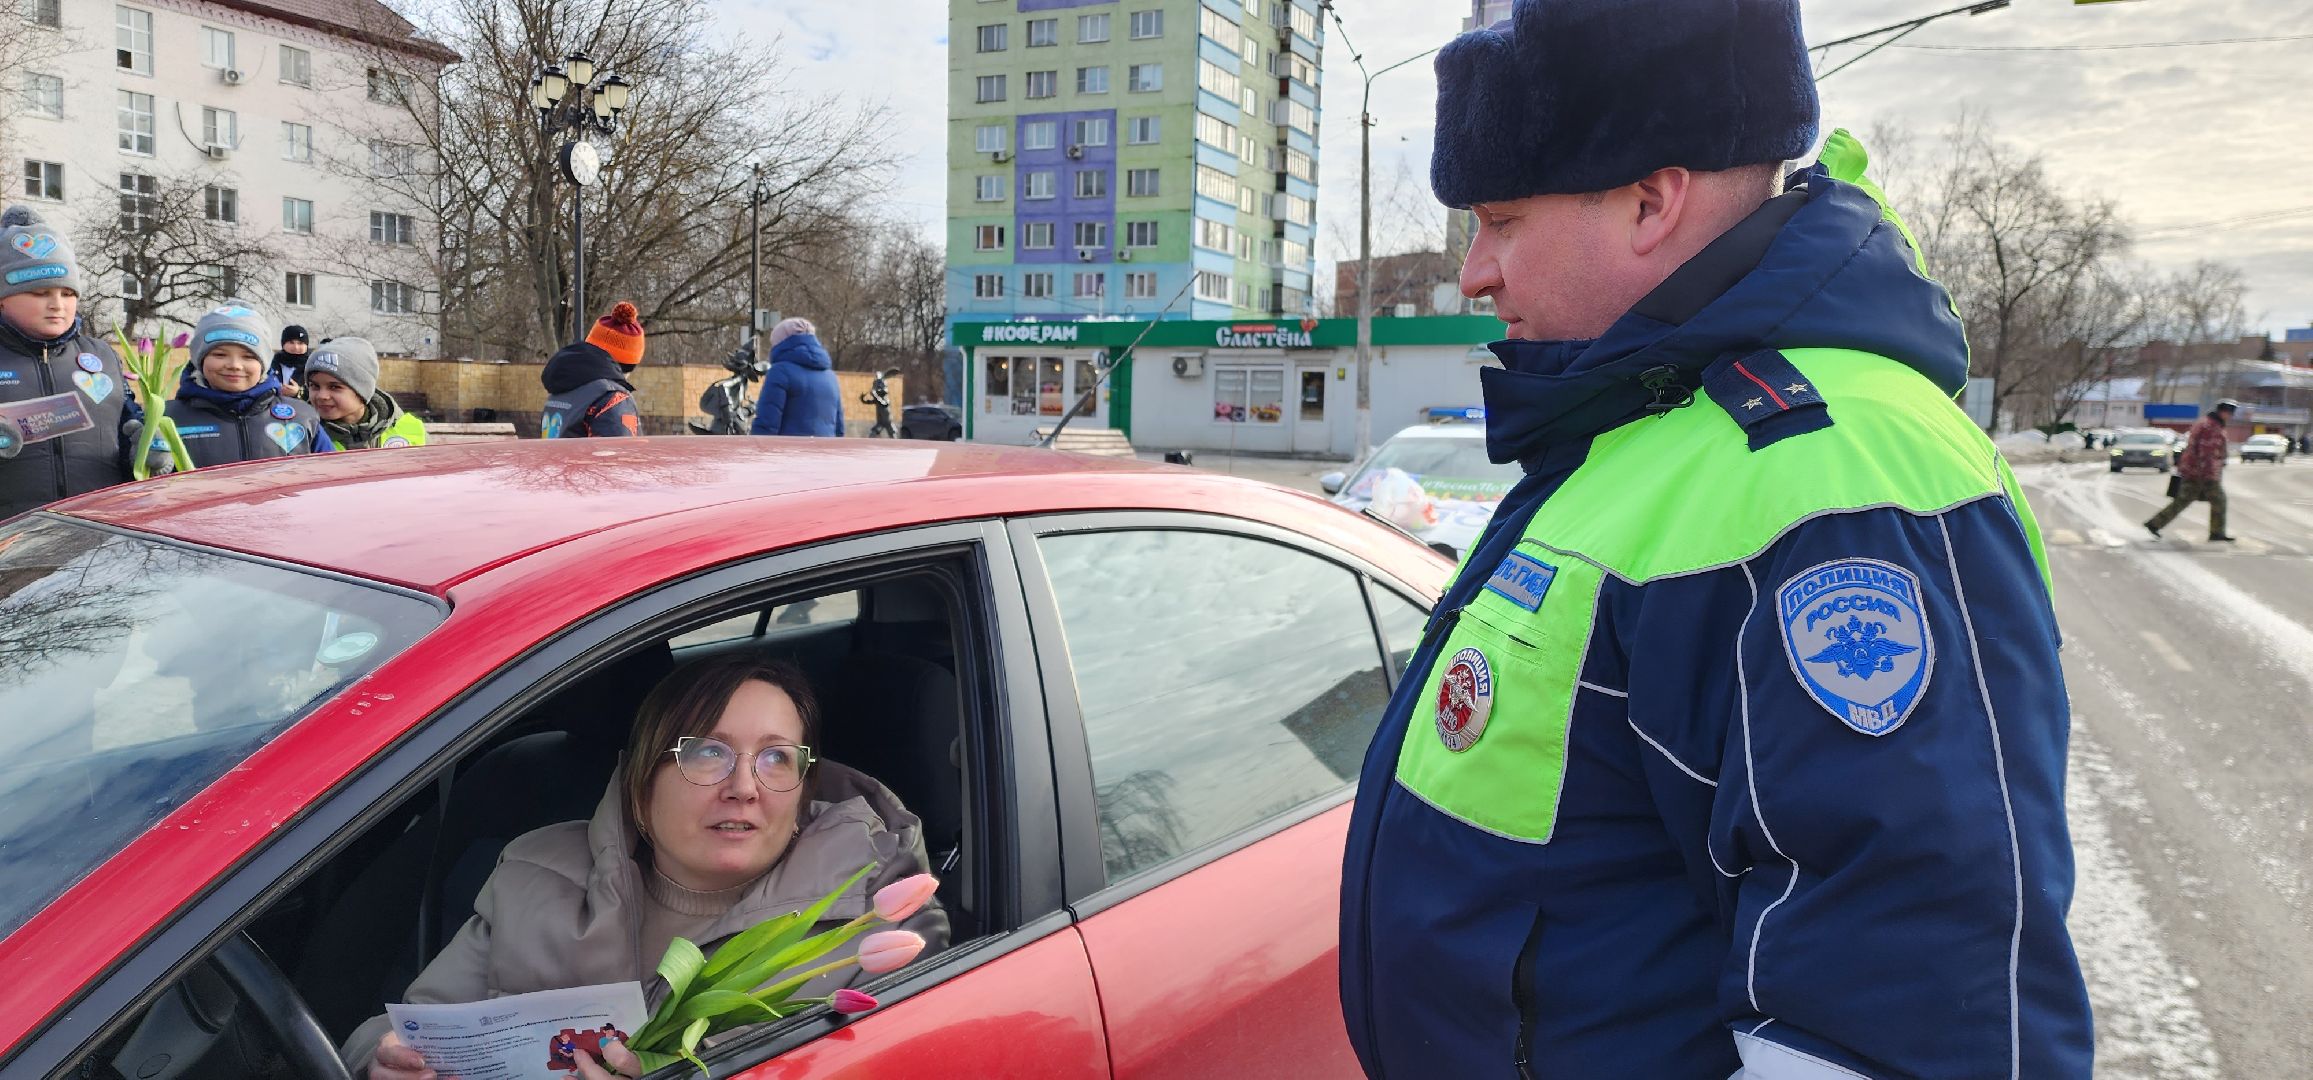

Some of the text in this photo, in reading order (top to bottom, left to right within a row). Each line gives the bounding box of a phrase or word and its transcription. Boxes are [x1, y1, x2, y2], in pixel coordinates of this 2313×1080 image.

[1788, 568, 1909, 612] ПОЛИЦИЯ
[1806, 594, 1902, 632] РОССИЯ
[1451, 649, 1488, 694] ПОЛИЦИЯ
[1440, 705, 1458, 731] ДПС
[1848, 699, 1898, 731] МВД
